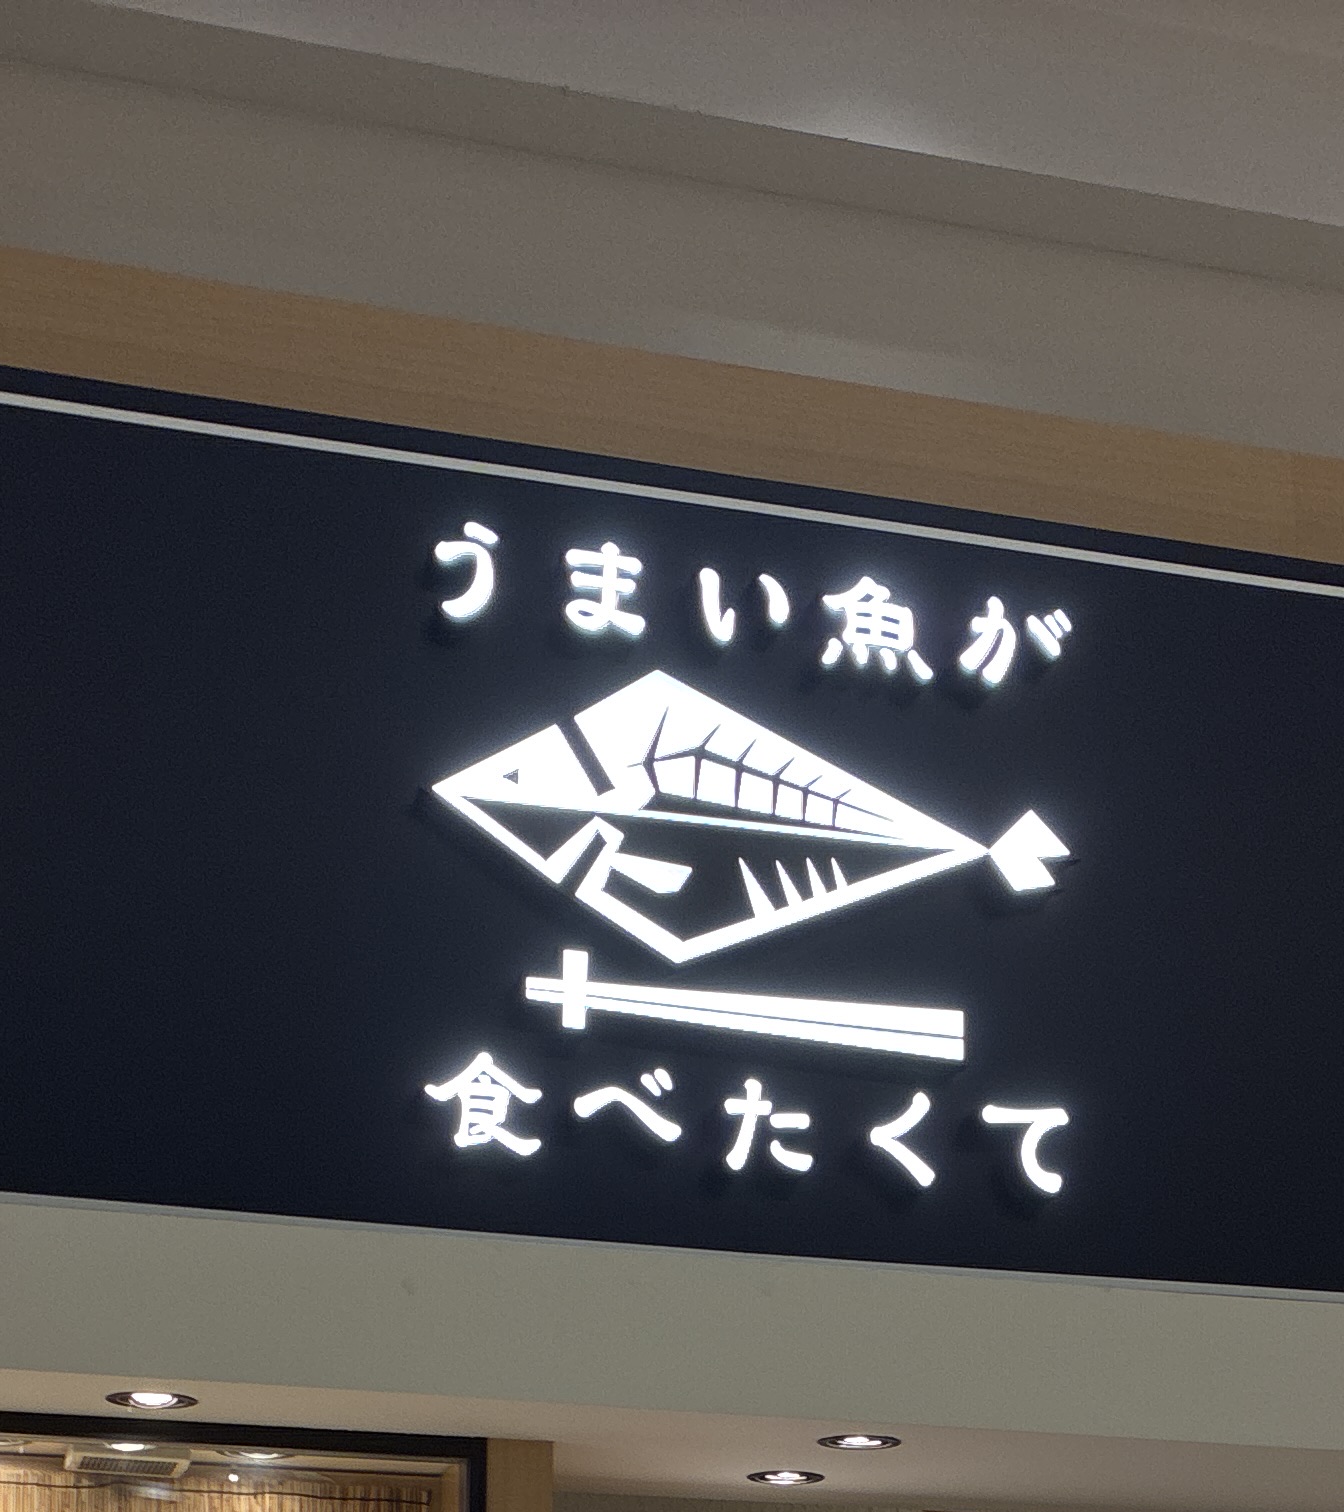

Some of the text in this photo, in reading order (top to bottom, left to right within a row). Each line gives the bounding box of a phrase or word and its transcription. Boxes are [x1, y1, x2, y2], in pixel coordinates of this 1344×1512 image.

[432, 519, 1074, 686] うまい魚が
[422, 1050, 1071, 1195] 食べたくて
